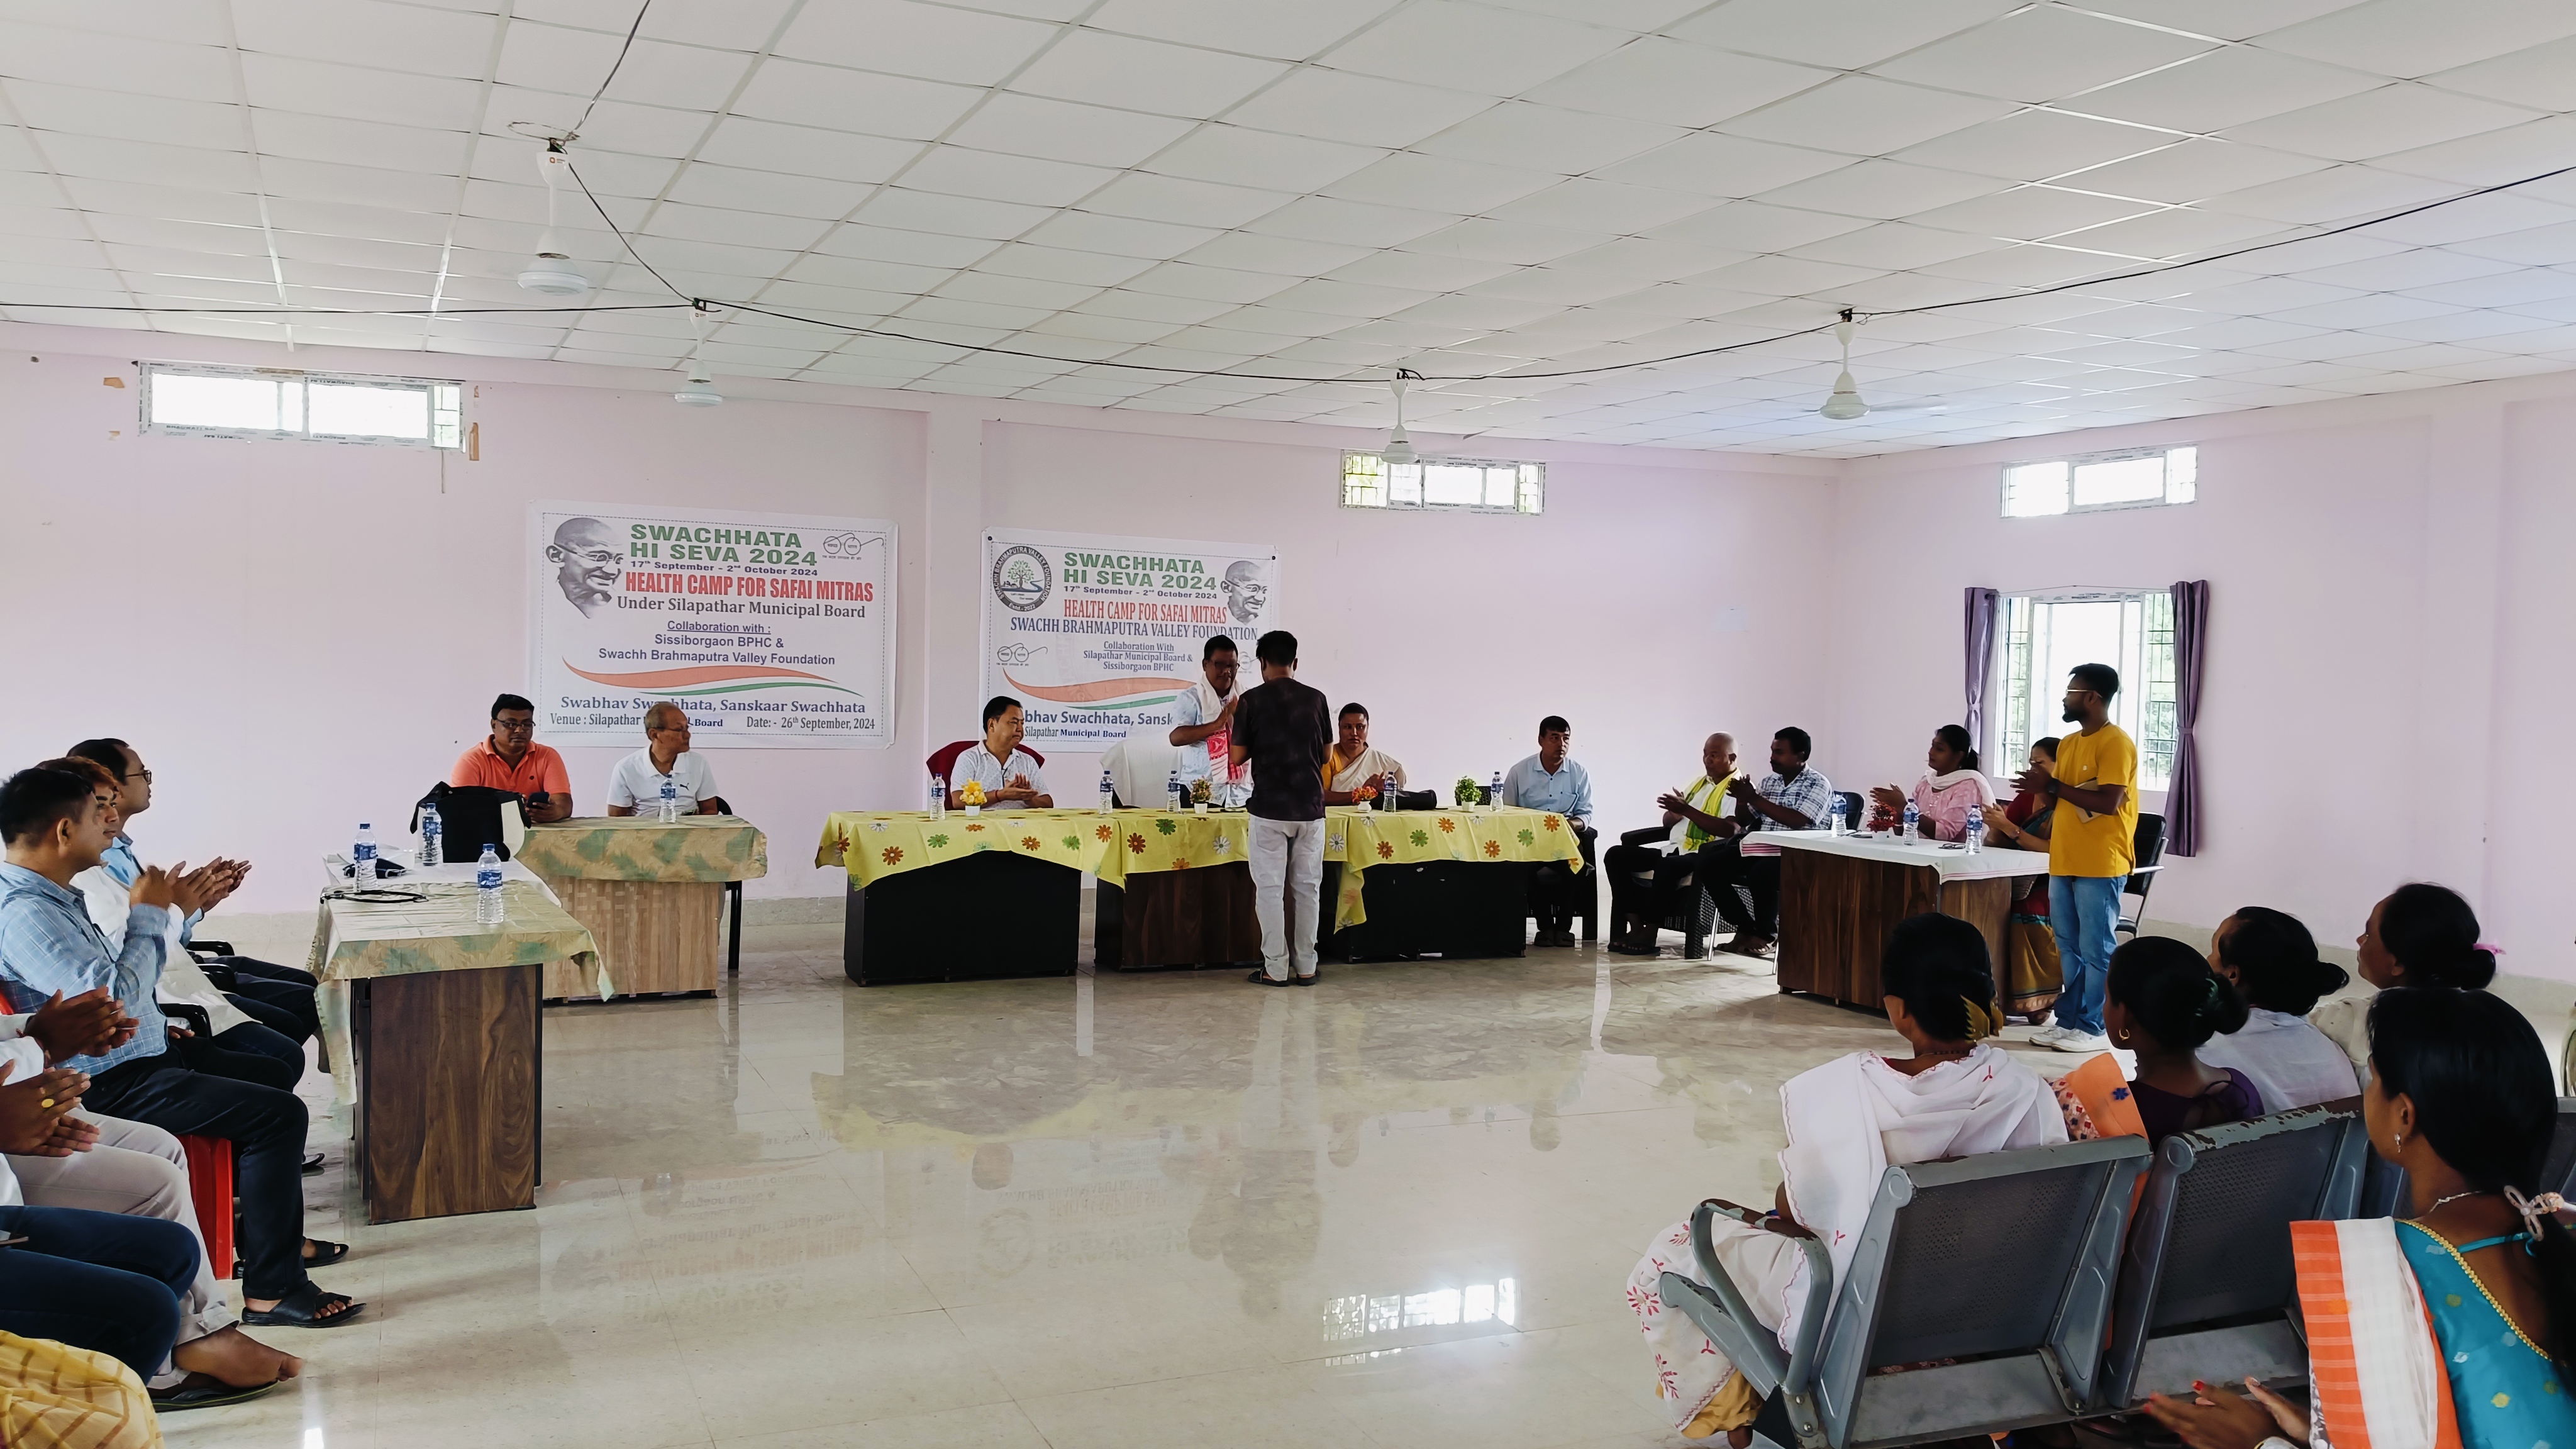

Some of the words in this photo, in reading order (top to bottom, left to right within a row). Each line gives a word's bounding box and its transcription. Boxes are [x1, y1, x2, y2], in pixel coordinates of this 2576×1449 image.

[631, 525, 802, 548] SWACHHATA
[631, 542, 658, 558] HI
[670, 544, 740, 563] SEVA
[750, 548, 818, 566] 2024
[655, 562, 714, 571] September
[745, 566, 787, 575] October
[791, 568, 818, 576] 2024
[1064, 552, 1204, 574] SWACHHATA
[626, 572, 683, 594] HEALTH
[687, 574, 733, 596] CAMP
[737, 577, 766, 597] FOR
[770, 578, 813, 599] SAFAI
[816, 580, 874, 602] MITRAS
[1064, 569, 1087, 584] HI
[1096, 570, 1153, 587] SEVA
[1161, 574, 1217, 591] 2024
[1084, 586, 1133, 596] September
[1157, 590, 1192, 598] October
[617, 596, 665, 610] Under
[668, 598, 745, 614] Silapathar
[749, 601, 820, 618] Municipal
[824, 604, 865, 618] Board
[1064, 599, 1104, 619] HEALTH
[1108, 601, 1136, 621] CAMP
[1138, 602, 1158, 621] FOR
[1160, 604, 1188, 623] SAFAI
[1191, 605, 1227, 625] MITRAS
[667, 621, 739, 632] Collaboration
[742, 623, 764, 633] with
[1011, 617, 1060, 633] SWACHH
[1063, 619, 1148, 636] BRAHMAPUTRA
[1151, 623, 1191, 638] VALLEY
[1193, 625, 1258, 640] FOUNDATION
[655, 634, 734, 648] Sissiborgaon
[738, 636, 772, 648] BPHC
[775, 638, 784, 648] &
[1104, 641, 1155, 651] Collaboration
[1157, 643, 1174, 652] With
[599, 648, 647, 660] Swachh
[651, 650, 729, 663] Brahmaputra
[733, 652, 767, 665] Valley
[771, 653, 835, 665] Foundation
[1084, 650, 1123, 661] Silapathar
[1124, 652, 1161, 662] Municipal
[1163, 653, 1185, 662] Board
[1103, 661, 1152, 672] Sissiborgaon
[1153, 663, 1174, 672] BPHC
[561, 696, 629, 709] Swabhav
[633, 698, 716, 712] Swhhata,
[720, 699, 787, 712] Sanskaar
[791, 701, 865, 713] Swachhata
[550, 713, 581, 725] Venue
[589, 714, 641, 728] Silapathar
[694, 718, 723, 727] Board
[747, 716, 771, 728] Date:
[781, 716, 799, 729] 26th
[800, 718, 852, 731] September,
[853, 718, 875, 730] 2024
[1024, 710, 1058, 723] bhav
[1061, 711, 1135, 726] Swachhata,
[1137, 713, 1174, 725] Sansk
[1024, 726, 1059, 739] Silapathar
[1060, 729, 1100, 738] Municipal
[1102, 730, 1126, 738] Board
